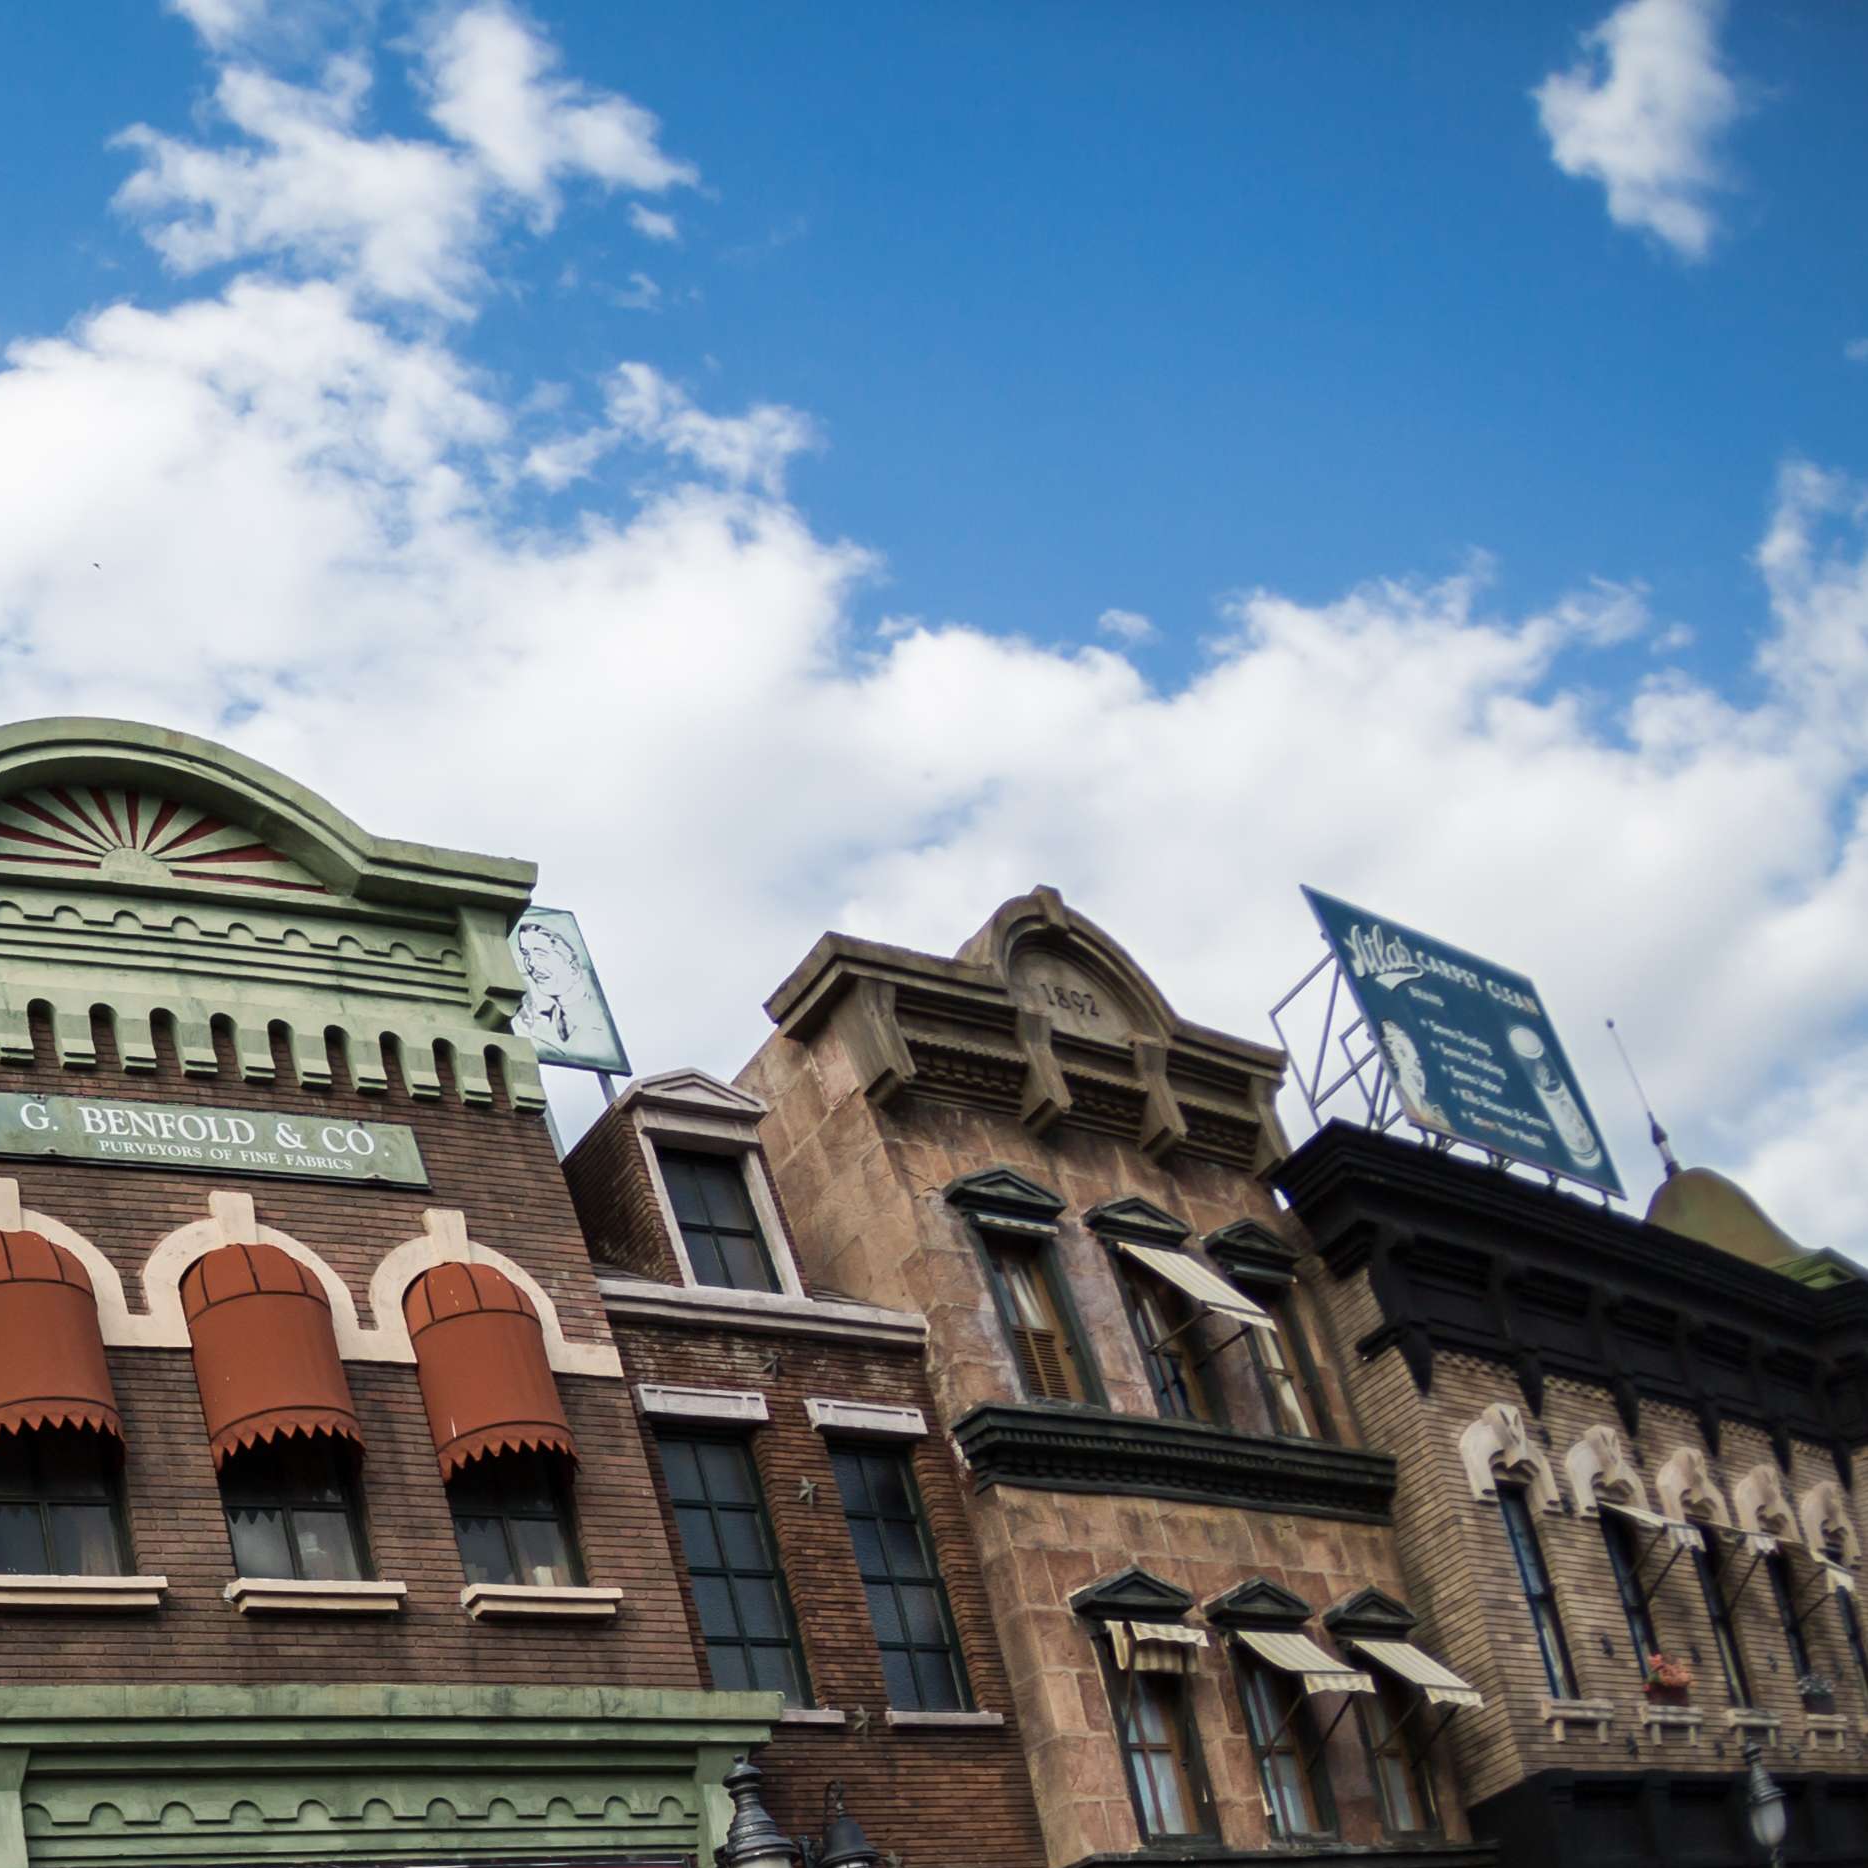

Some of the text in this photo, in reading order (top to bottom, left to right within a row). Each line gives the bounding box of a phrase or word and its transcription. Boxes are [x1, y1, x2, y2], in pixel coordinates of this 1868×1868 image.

[1343, 924, 1418, 981] Atlas
[1039, 983, 1100, 1017] 1892
[20, 1102, 59, 1132] G.
[78, 1106, 256, 1145] BENFOLD
[275, 1122, 308, 1150] &
[99, 1139, 354, 1171] PURVEYORS OF FINE FABRICS
